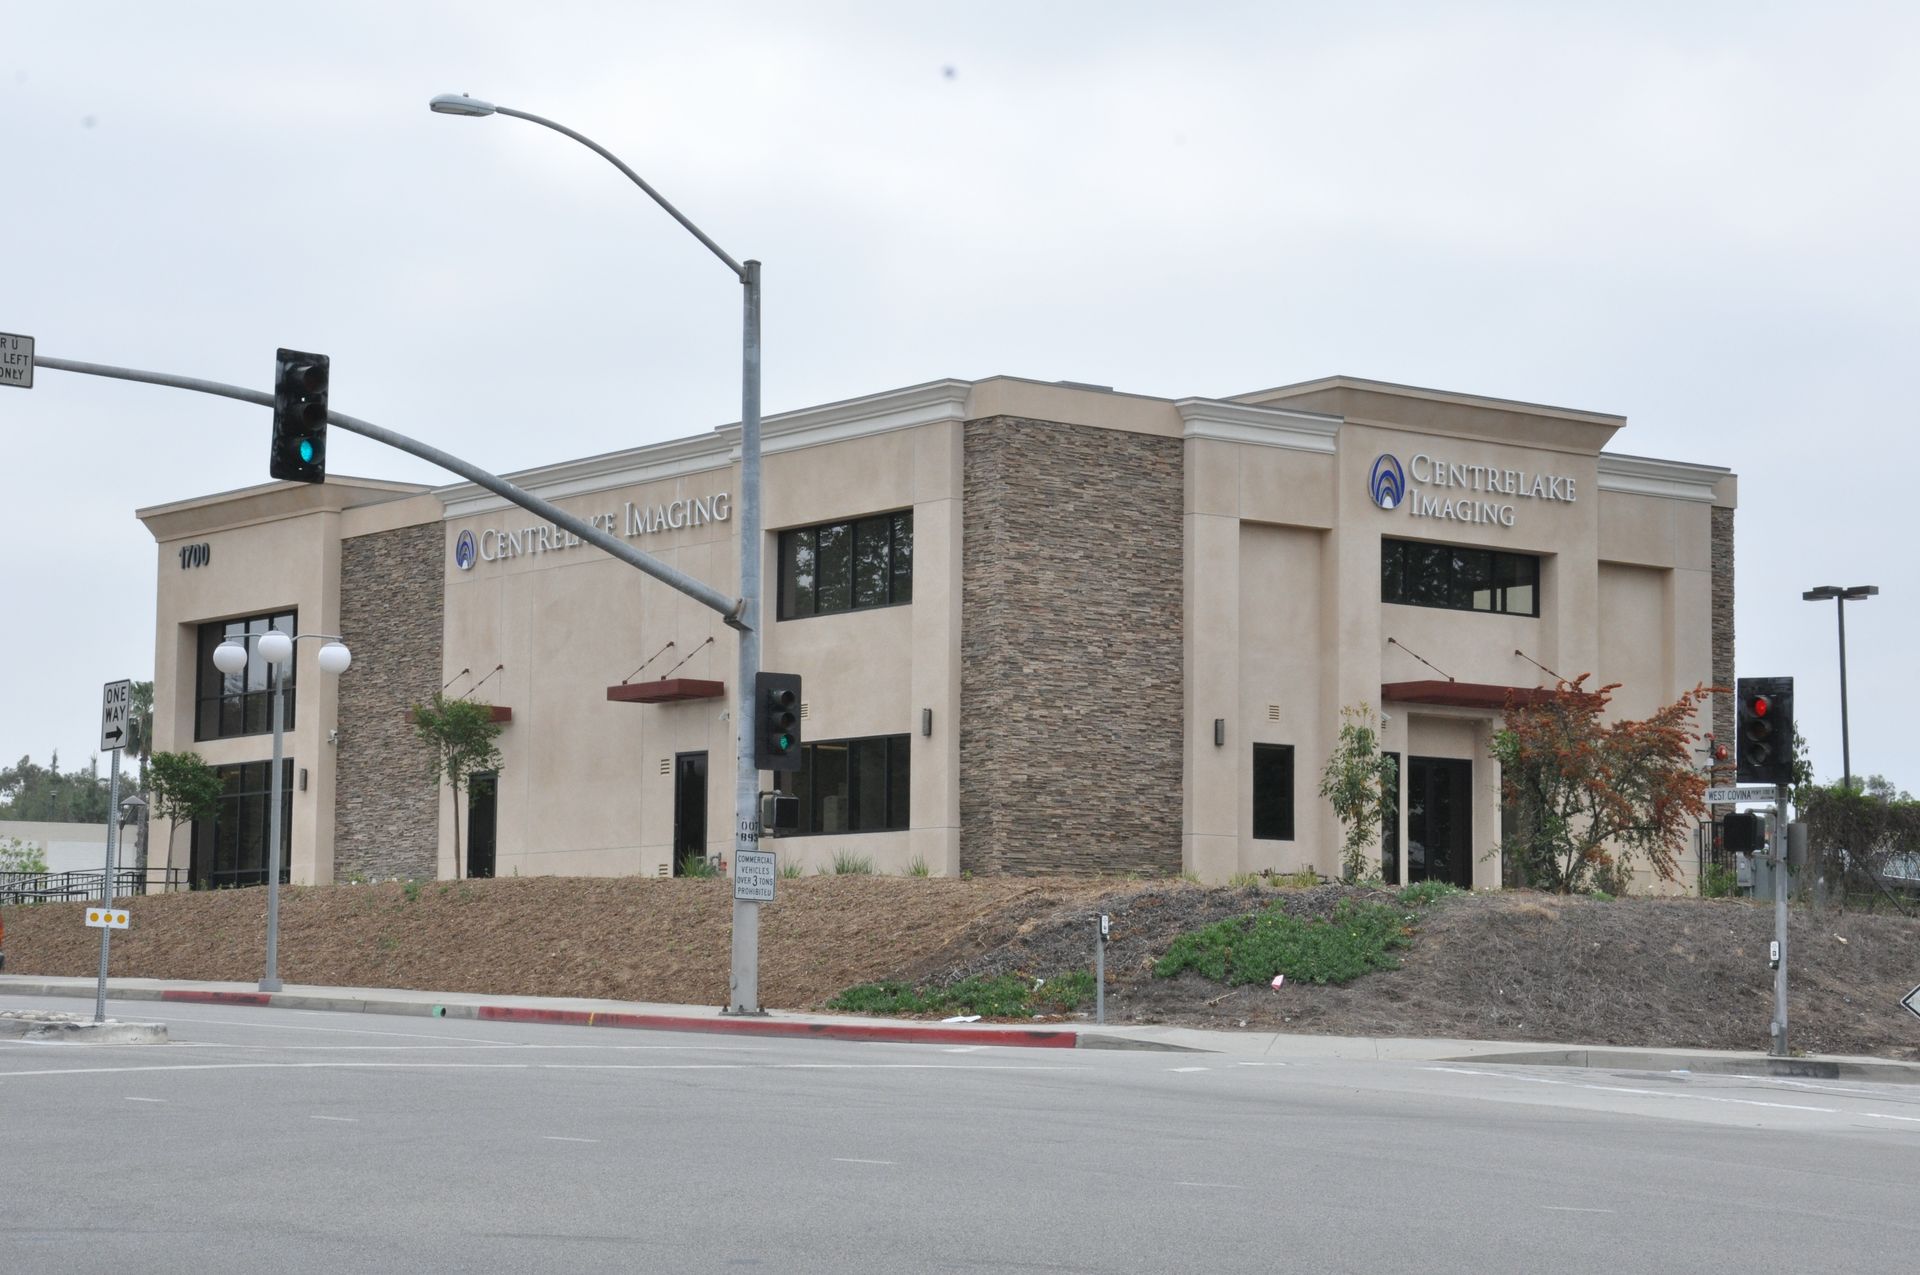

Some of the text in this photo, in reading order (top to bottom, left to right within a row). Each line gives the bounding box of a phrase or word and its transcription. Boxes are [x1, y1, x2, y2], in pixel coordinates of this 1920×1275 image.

[12, 338, 18, 350] U
[4, 352, 29, 366] LEFT
[179, 542, 210, 570] 1700
[106, 686, 127, 704] ONE
[105, 705, 126, 723] WAY
[1708, 790, 1725, 801] WEST
[1727, 790, 1751, 801] COVINA
[738, 855, 773, 865] COMMERCIAL
[741, 866, 770, 875] VEHICLES
[737, 875, 773, 887] OVER 3 TONS
